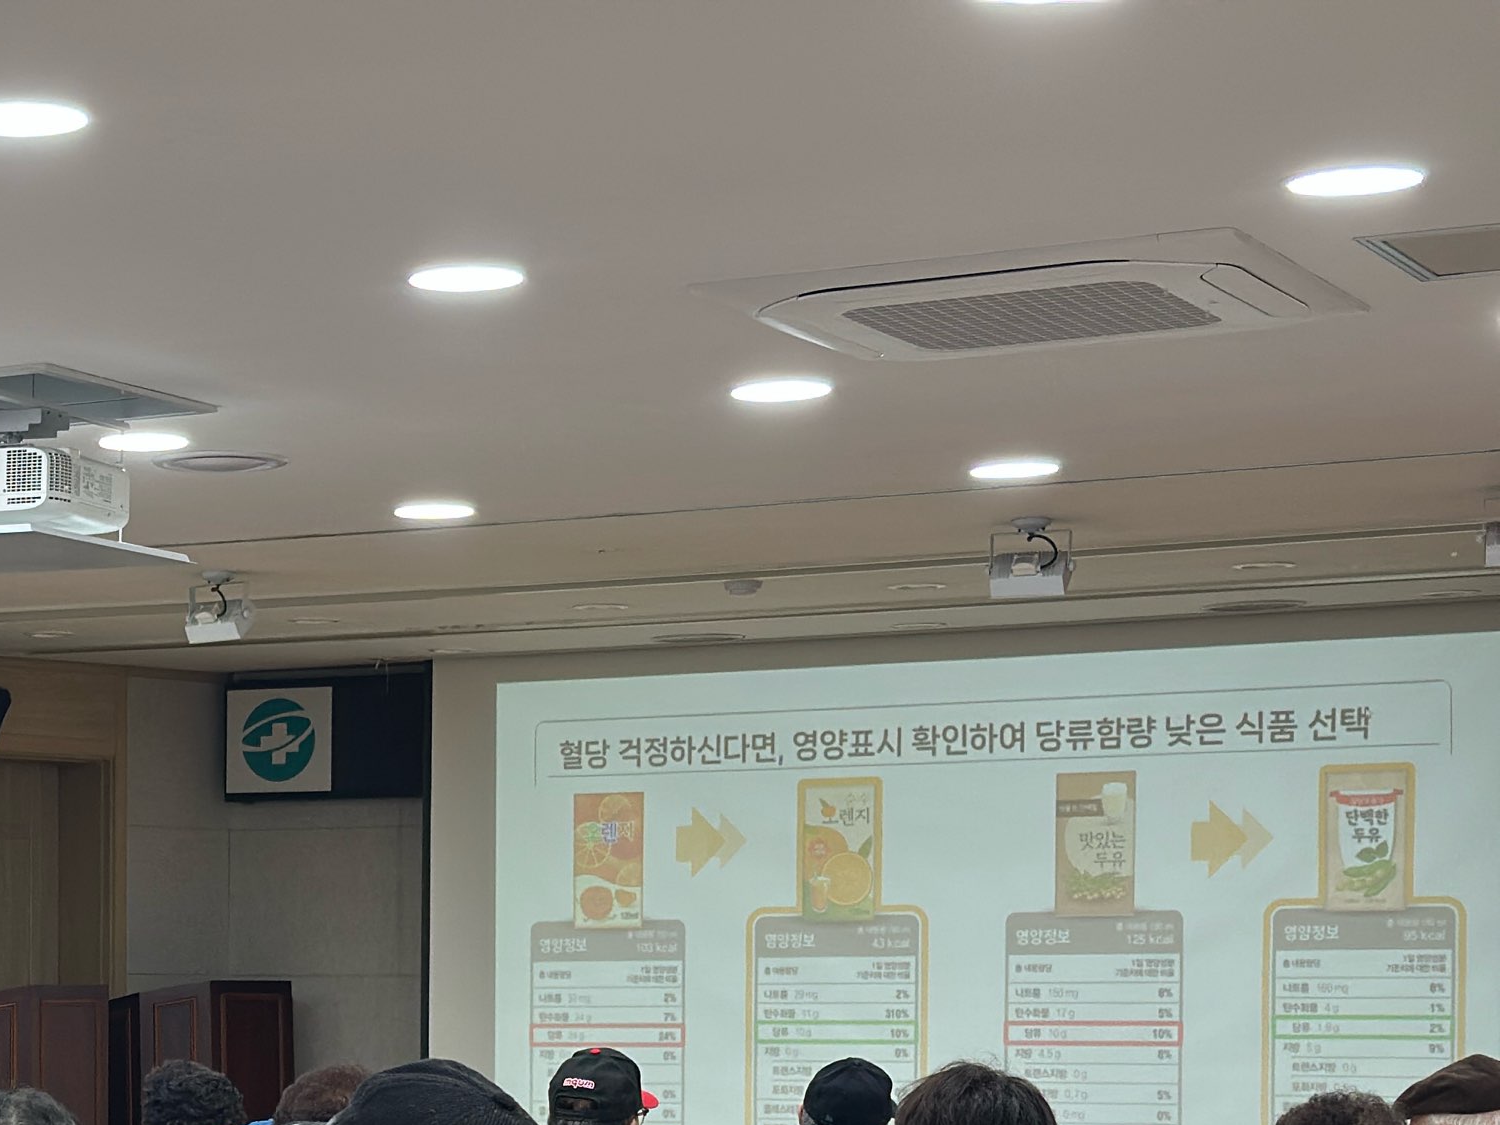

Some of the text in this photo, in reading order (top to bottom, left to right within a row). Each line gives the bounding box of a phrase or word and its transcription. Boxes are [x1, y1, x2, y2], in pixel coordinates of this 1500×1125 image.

[559, 706, 1371, 771] 혈당 걱정하신다면, 영양표시 확인하여 당류함량 낮은 식품 선택
[1079, 831, 1126, 851] 맛있는
[1351, 828, 1383, 843] 두유
[1093, 852, 1126, 868] 두유
[764, 933, 816, 949] 영양정보
[1016, 929, 1071, 945] 영양정보
[1284, 925, 1339, 941] 영양정보
[539, 938, 588, 953] 영양정보
